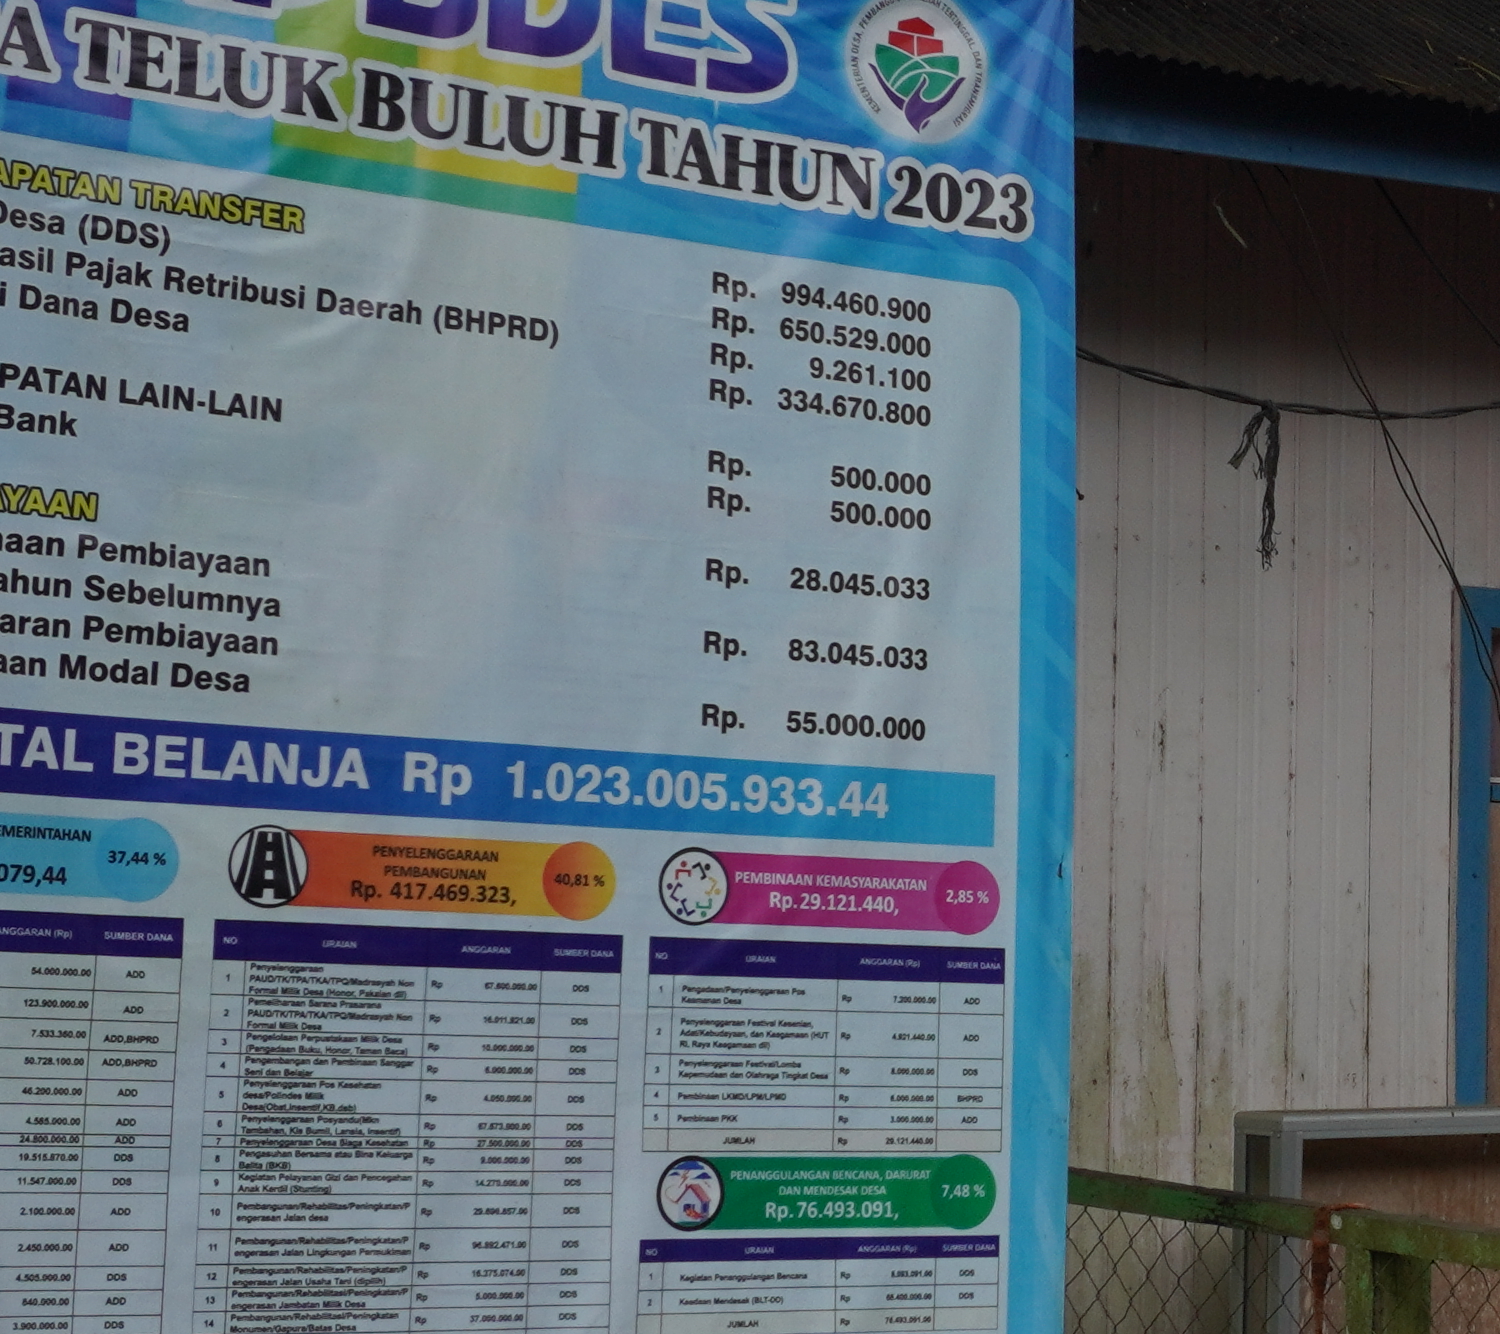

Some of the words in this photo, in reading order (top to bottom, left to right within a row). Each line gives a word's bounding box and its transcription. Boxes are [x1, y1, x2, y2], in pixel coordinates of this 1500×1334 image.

[75, 18, 338, 122] TELUK
[358, 68, 619, 169] BULUH
[638, 118, 875, 210] TAHUN
[892, 166, 1027, 233] 2023
[129, 179, 305, 234] TRANSFER
[79, 214, 170, 256] (DDS)
[66, 252, 152, 288] Pajak
[164, 266, 305, 309] Retribusi
[316, 288, 422, 325] Daerah
[434, 305, 558, 349] (BHPRD)
[713, 272, 755, 302] Rp.
[782, 282, 931, 323] 994.460.900
[780, 318, 931, 357] 650.529.000
[119, 379, 282, 422] LAIN-LAIN
[77, 534, 269, 578] Pembiayaan
[84, 575, 280, 621] Sebelumnya
[791, 568, 929, 600] 28.045.033
[789, 639, 927, 670] 83.045.033
[114, 732, 370, 789] BELANJA
[404, 752, 472, 805] Rp
[508, 761, 889, 819] 1.023.005.933.44
[735, 870, 812, 889] PEMBINAAN
[816, 872, 927, 893] KEMASYARAKATAN
[145, 932, 174, 943] DANA
